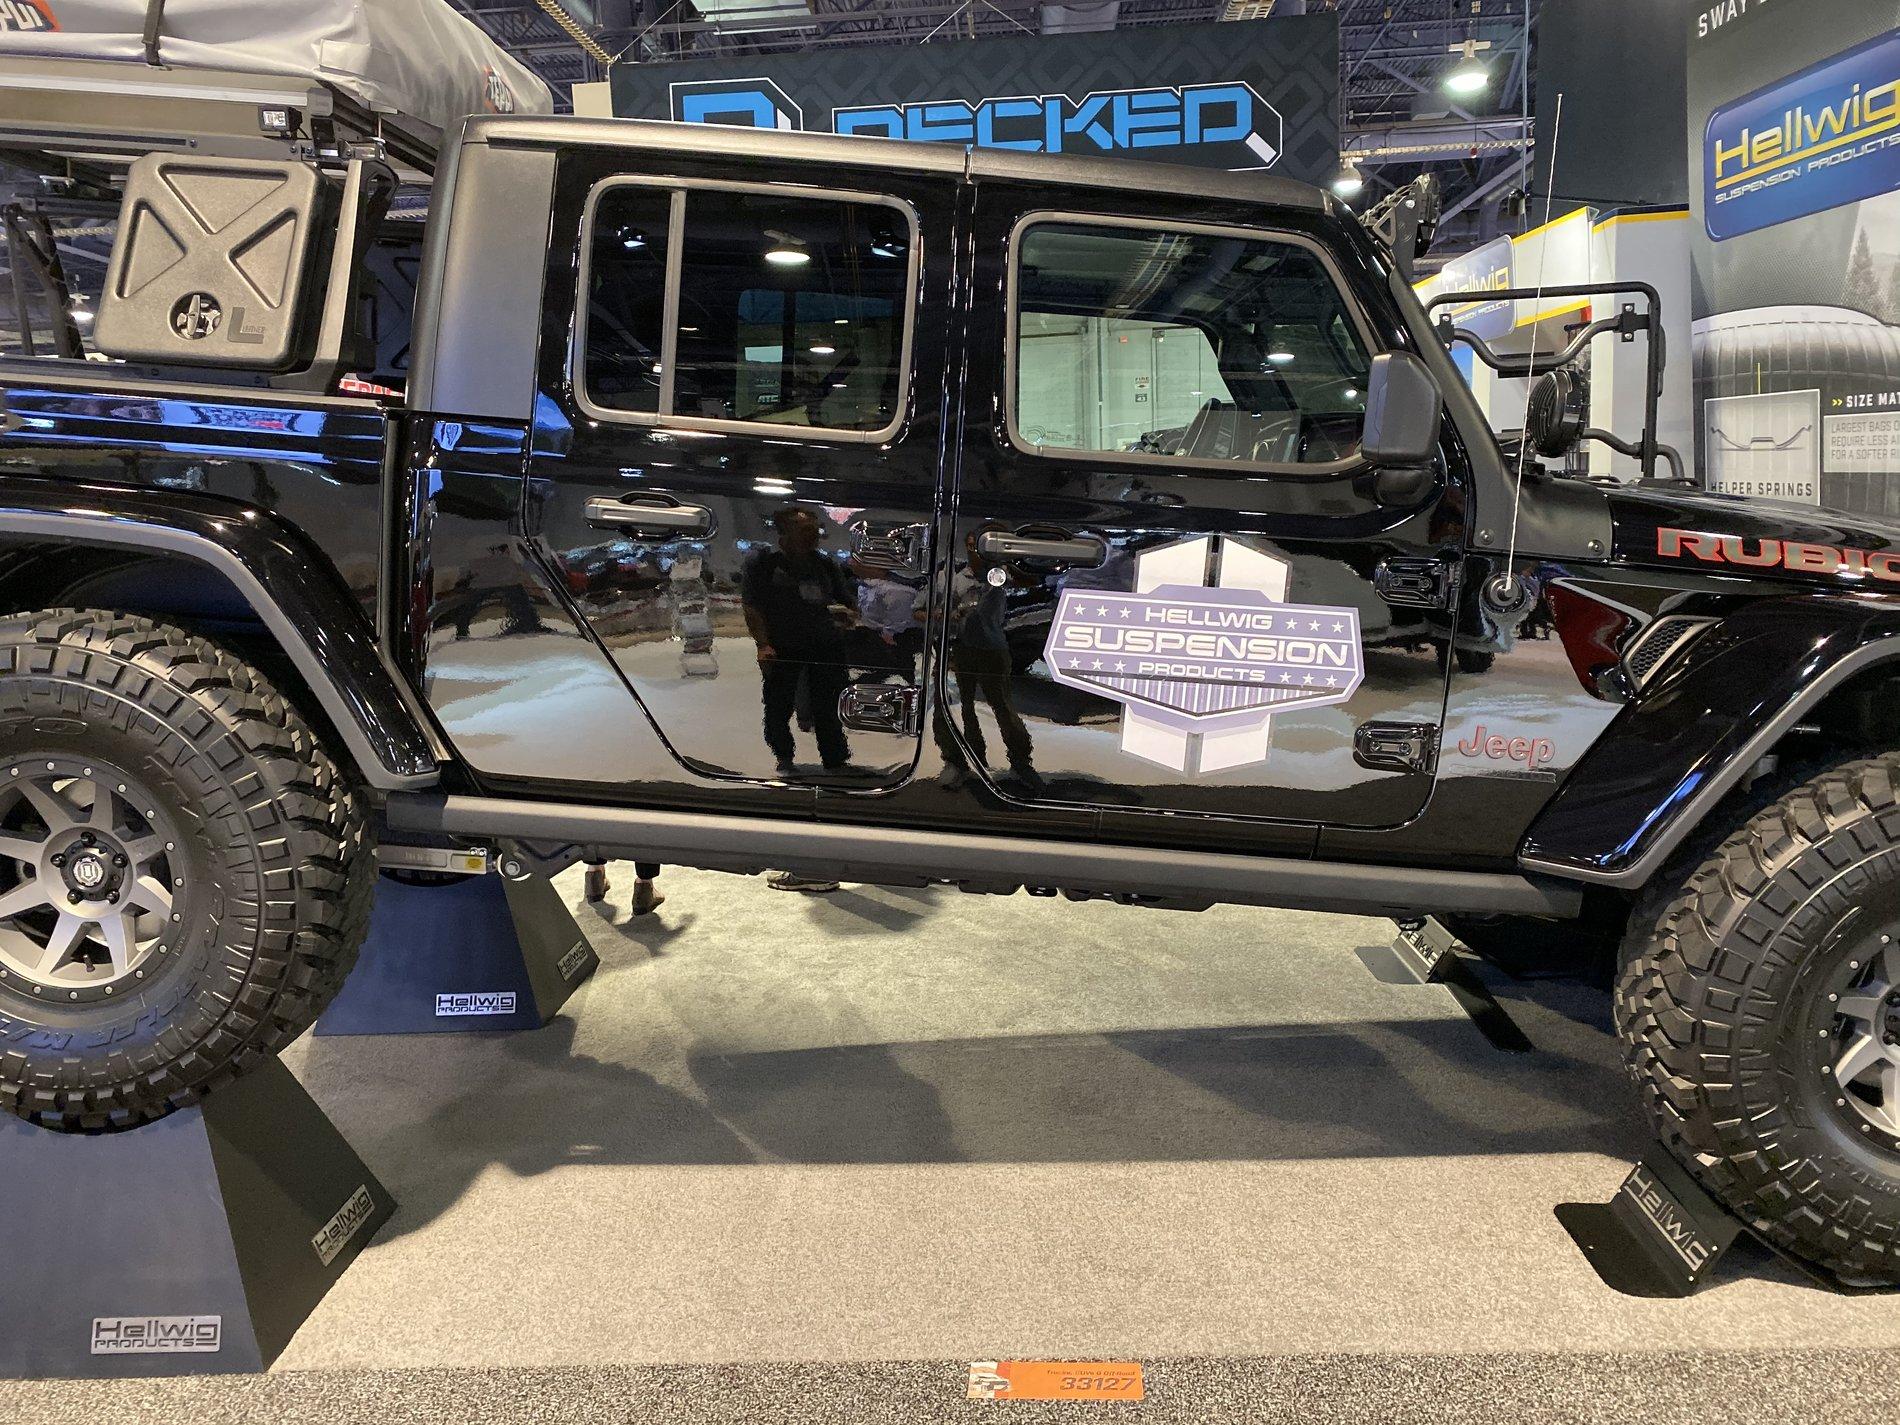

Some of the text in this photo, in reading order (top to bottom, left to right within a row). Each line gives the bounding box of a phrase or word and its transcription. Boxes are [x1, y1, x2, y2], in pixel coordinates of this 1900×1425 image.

[1715, 79, 1900, 178] Hellwig
[1715, 133, 1900, 204] SUSPENSION PRODUCTS
[1846, 394, 1873, 408] SIZE
[1831, 422, 1867, 433] LARGEST
[1869, 421, 1891, 432] BAGS
[1831, 436, 1865, 447] REQUIRE
[1867, 435, 1888, 446] LESS
[1831, 450, 1846, 459] FOR
[1848, 450, 1854, 459] A
[1856, 449, 1888, 460] SOFTER
[1711, 482, 1812, 497] HELPER SPRINGS
[1145, 606, 1273, 630] HELLWIG
[1063, 626, 1348, 666] SUSPENSION
[1138, 661, 1266, 682] PRODUCTS
[1458, 725, 1556, 768] Jeep
[437, 993, 515, 1009] Hellwig
[314, 1191, 373, 1252] Hellwig
[1622, 1168, 1710, 1272] Hellwig
[95, 1318, 218, 1342] Hellwig
[95, 1338, 195, 1349] PRODUCTS
[1060, 1377, 1136, 1391] 33127
